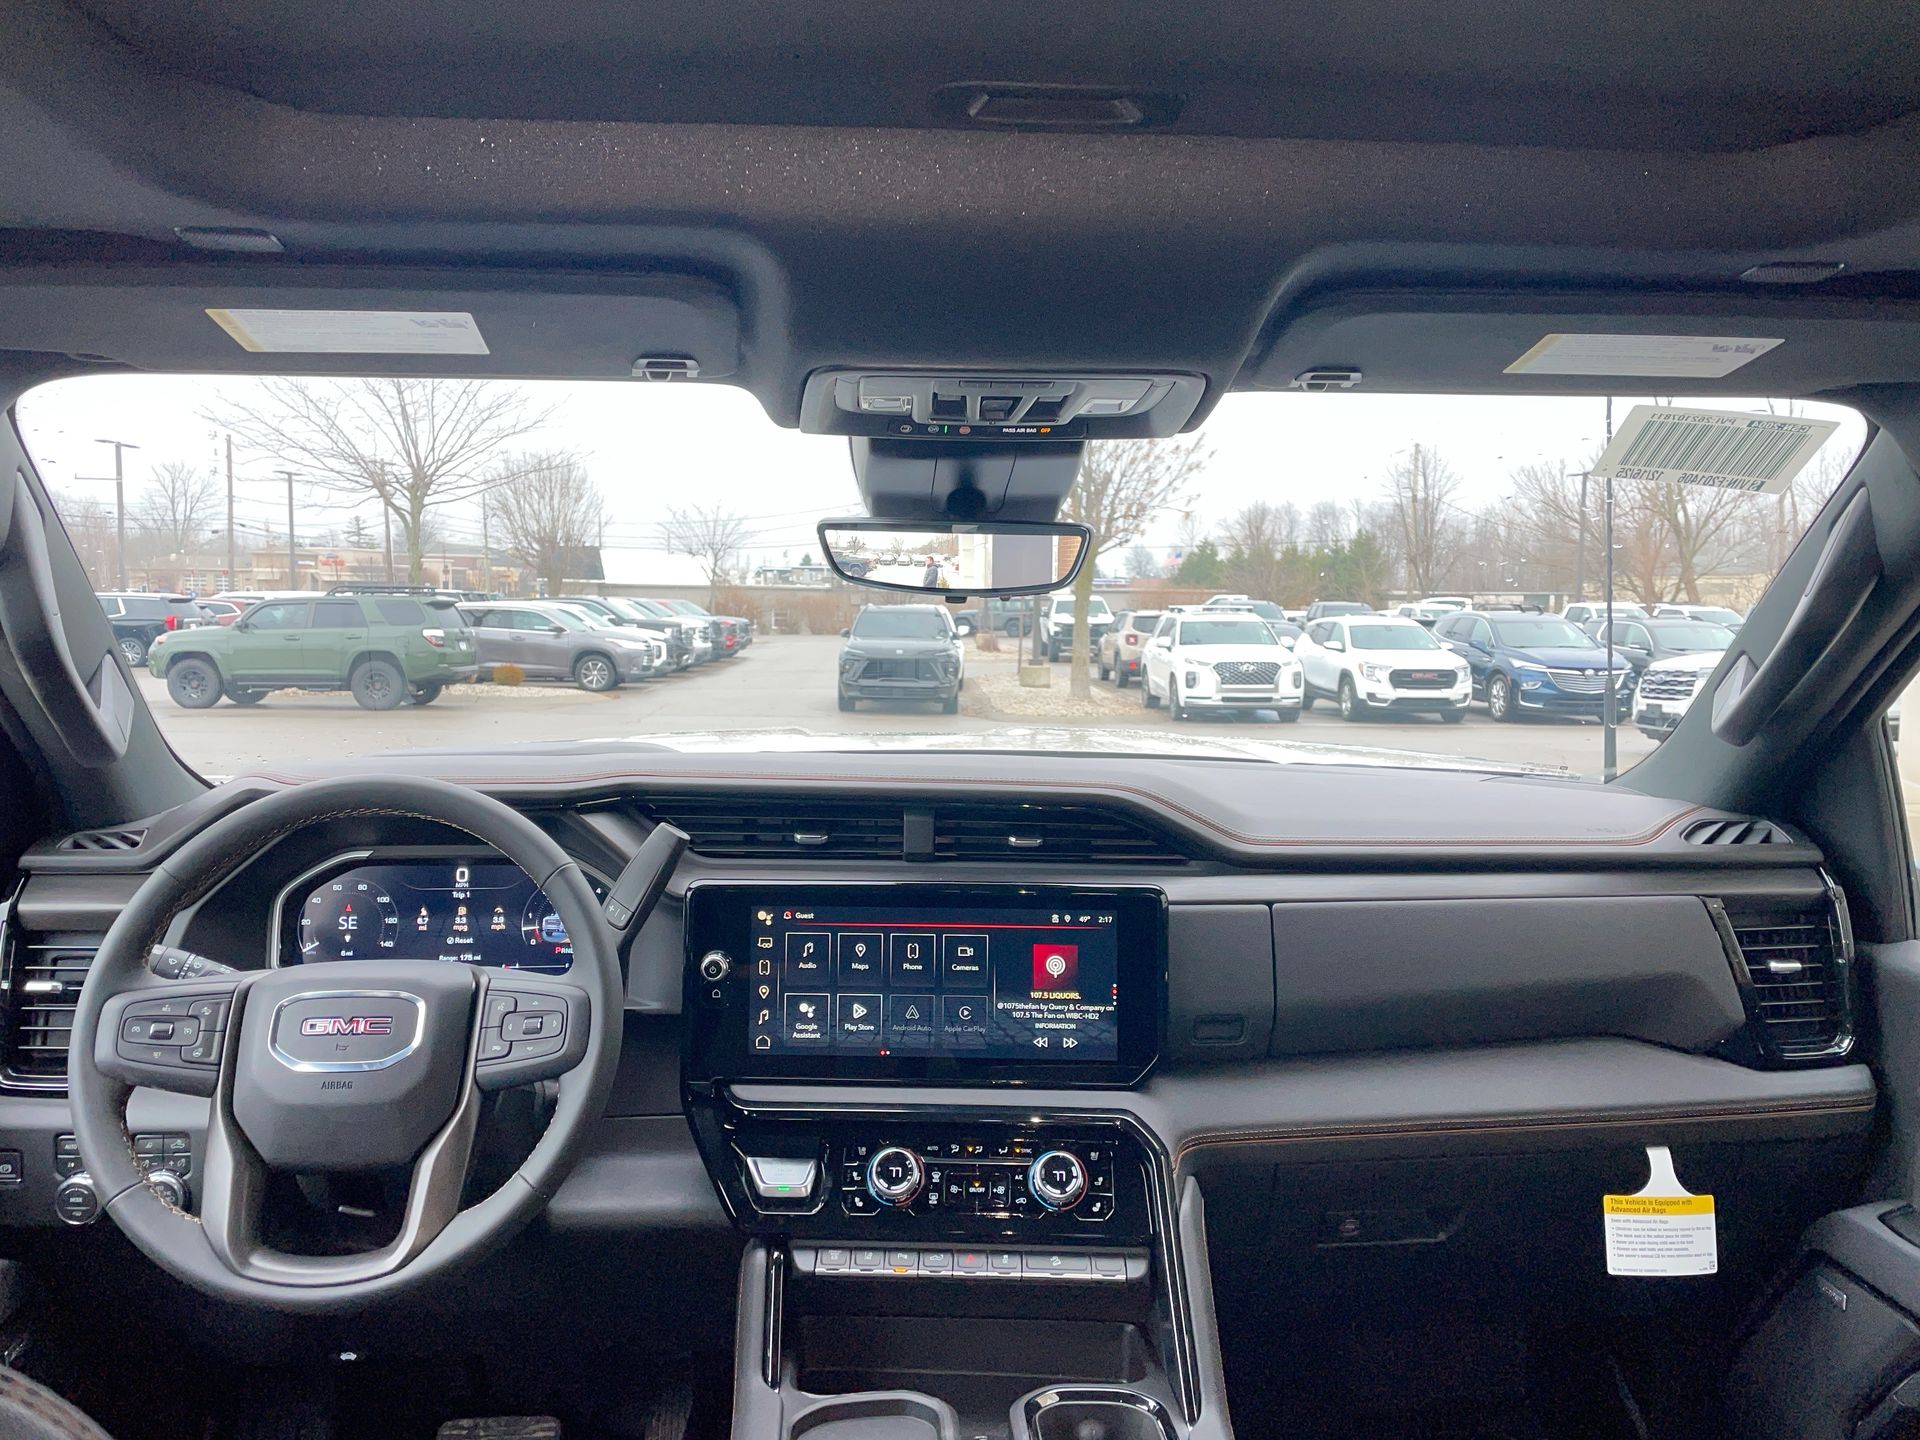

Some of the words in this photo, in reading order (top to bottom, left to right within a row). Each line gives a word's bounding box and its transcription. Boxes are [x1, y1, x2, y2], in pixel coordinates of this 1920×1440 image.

[1411, 671, 1438, 681] GMC
[456, 868, 469, 883] 0
[795, 912, 815, 920] Guest
[1098, 916, 1113, 924] 2:17
[301, 918, 311, 926] 20
[338, 916, 358, 930] SE
[491, 923, 505, 931] mph
[798, 962, 817, 970] Audio
[851, 963, 870, 971] Maps
[902, 963, 923, 971] Phone
[951, 964, 980, 972] Cameras
[1030, 991, 1049, 999] 107.5
[1040, 1003, 1048, 1011] by
[1048, 1003, 1068, 1011] Query
[1075, 1004, 1105, 1012] Company
[301, 1016, 392, 1035] GMC
[795, 1022, 818, 1031] Google
[844, 1023, 858, 1032] Play
[858, 1023, 875, 1031] Store
[944, 1025, 961, 1033] Apple
[962, 1025, 987, 1033] CarPlay
[1034, 1022, 1077, 1030] INFORMATION
[792, 1031, 821, 1039] Assistant
[320, 1080, 353, 1090] AIRBAG
[889, 1167, 902, 1178] 77
[1053, 1170, 1065, 1181] 77
[1654, 1199, 1681, 1207] Equipped
